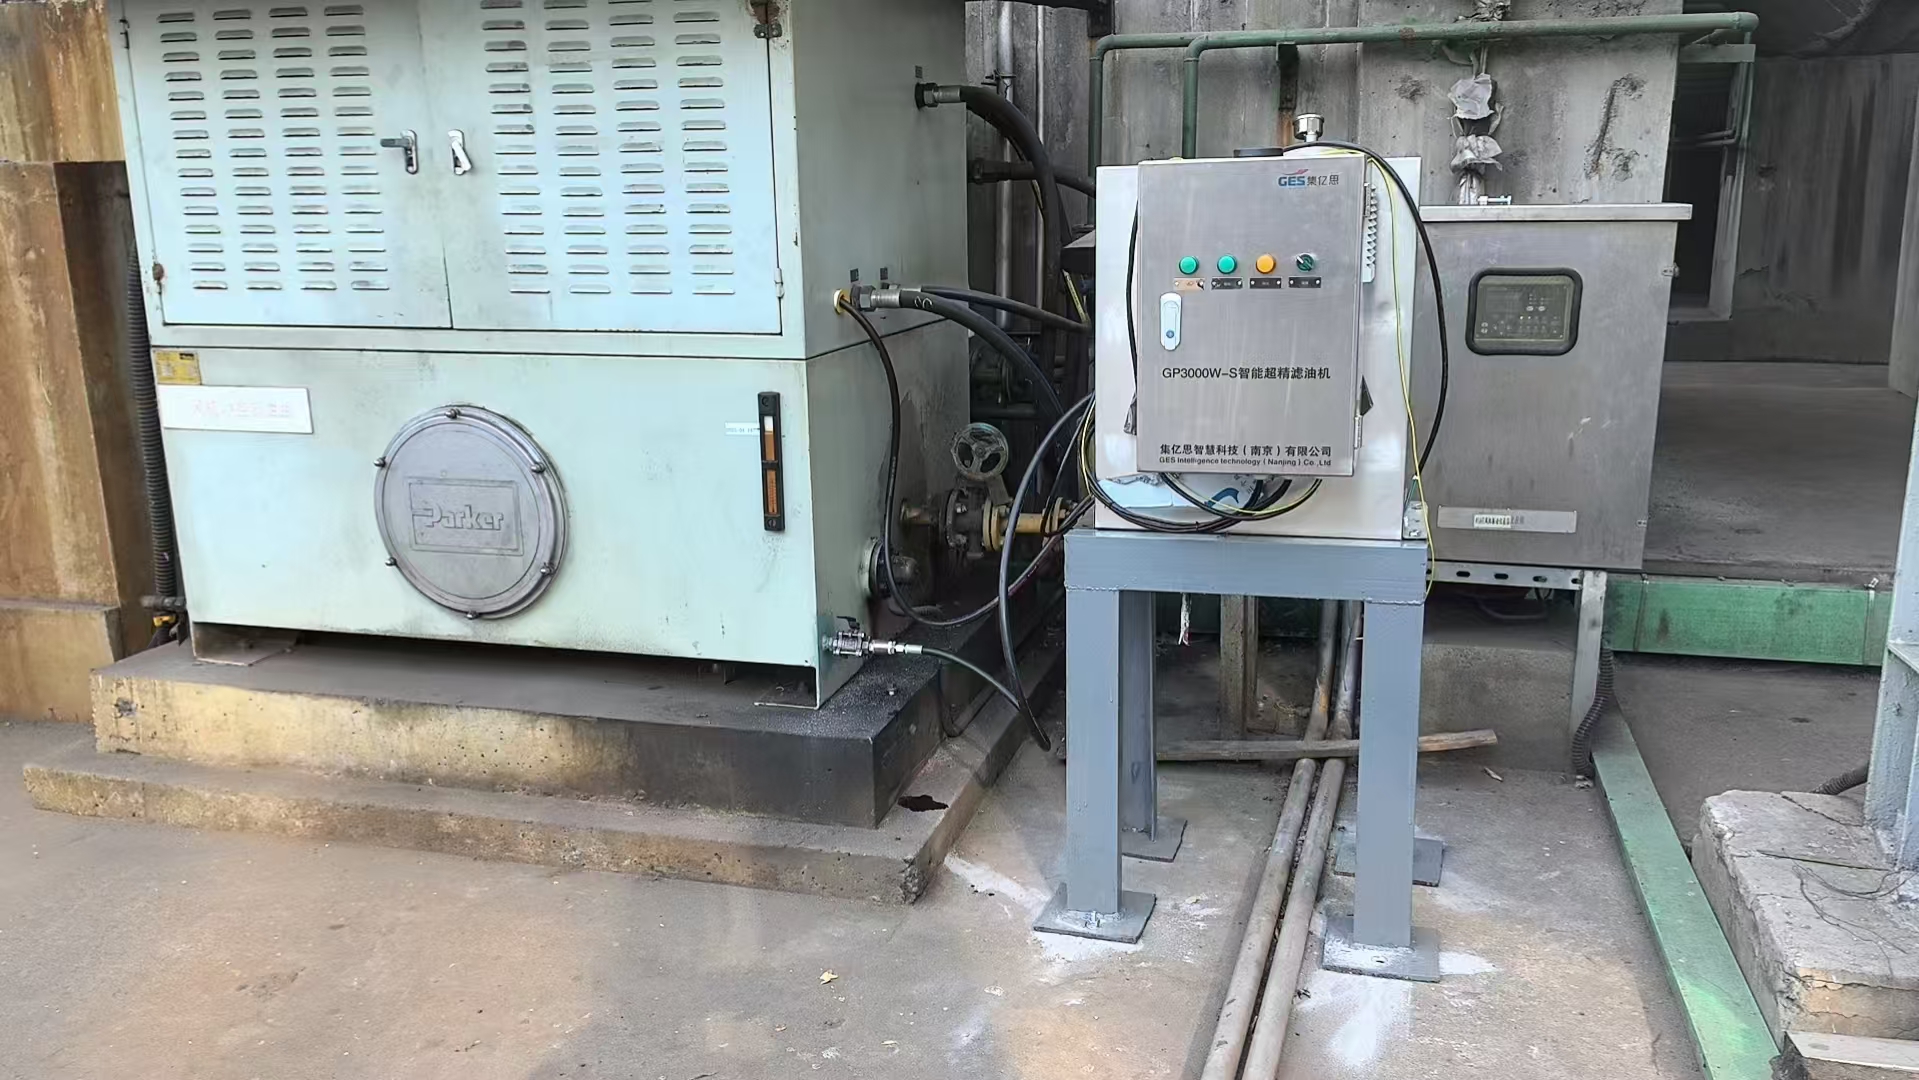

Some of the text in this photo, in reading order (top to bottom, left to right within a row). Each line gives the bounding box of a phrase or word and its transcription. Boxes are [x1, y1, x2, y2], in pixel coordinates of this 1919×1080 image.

[1278, 175, 1339, 186] GES 集亿思
[1159, 456, 1176, 464] GES
[1220, 458, 1261, 466] technology
[412, 502, 504, 530] Parker
